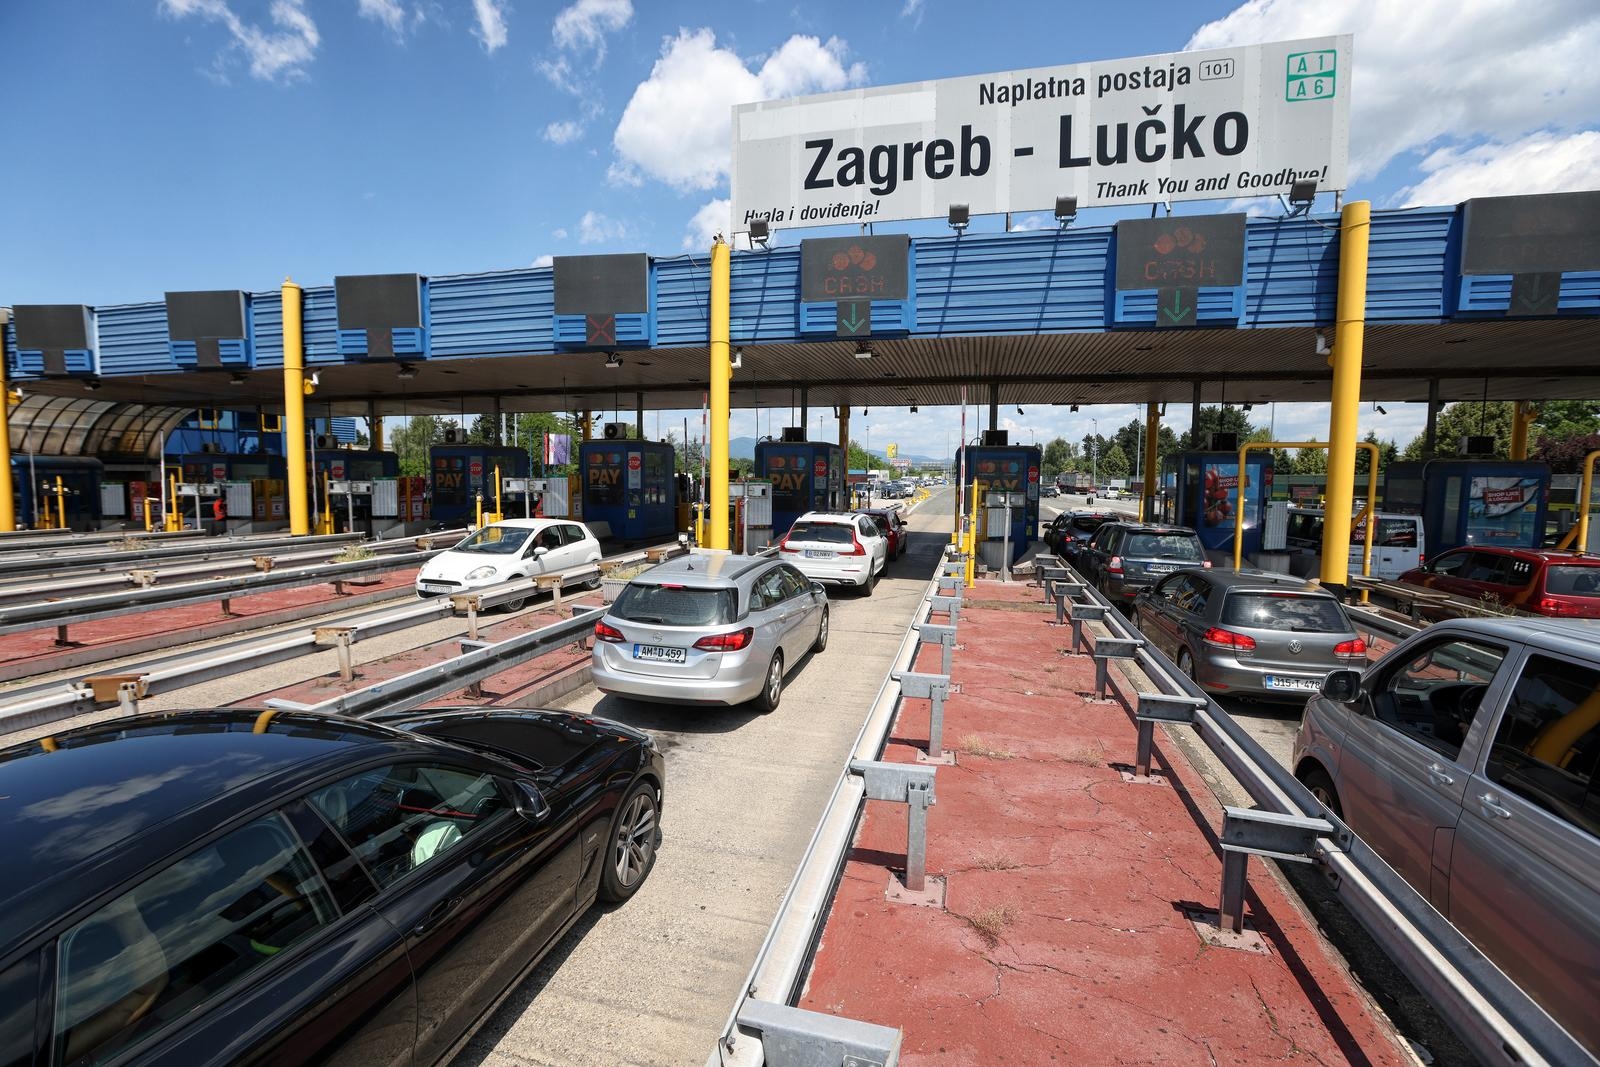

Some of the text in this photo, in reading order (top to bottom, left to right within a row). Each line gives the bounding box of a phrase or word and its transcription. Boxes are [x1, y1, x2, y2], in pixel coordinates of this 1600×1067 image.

[1298, 54, 1324, 73] A 1
[979, 62, 1230, 107] Naplatna postaja 101
[1296, 79, 1324, 97] A 6
[804, 125, 991, 196] Zagreb
[1058, 104, 1250, 169] Lučko
[1097, 180, 1149, 198] Thank
[1157, 178, 1189, 194] You
[1194, 174, 1230, 192] and
[788, 206, 795, 220] i
[800, 199, 880, 220] doviđenja!
[436, 473, 462, 487] PAY
[589, 469, 621, 484] PAY
[769, 473, 806, 490] PAY
[641, 646, 682, 659] AM D 459
